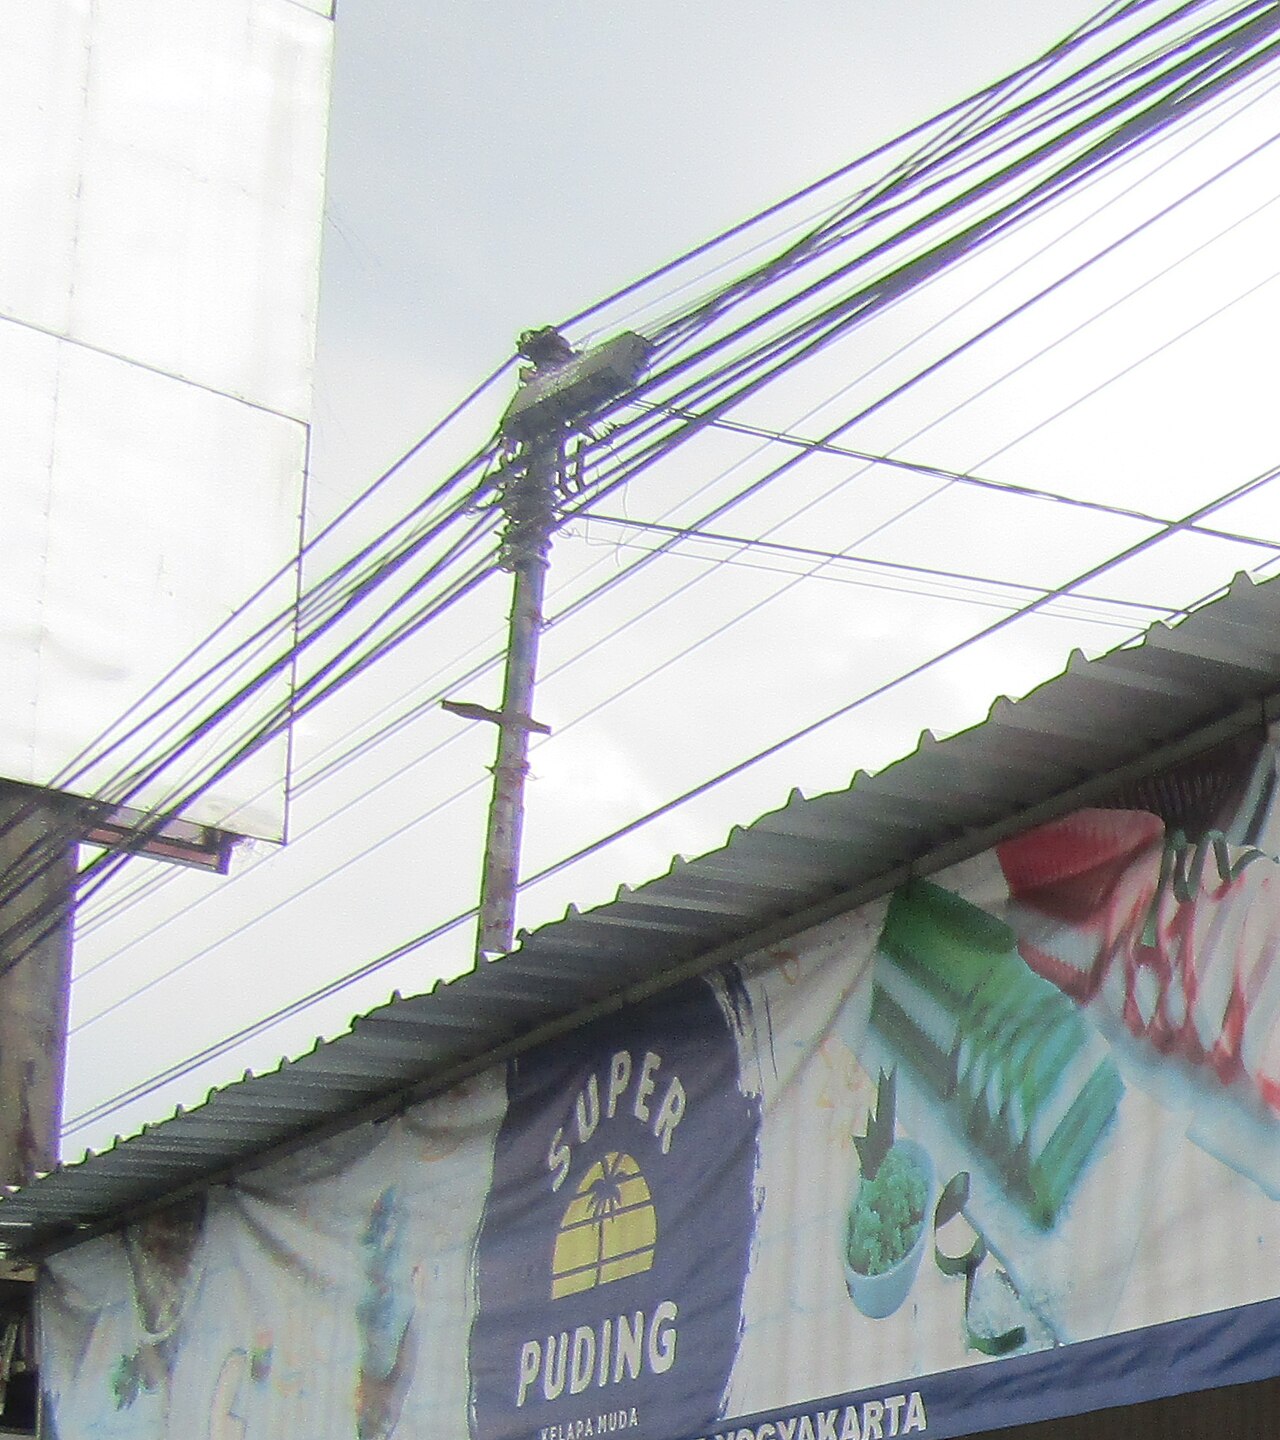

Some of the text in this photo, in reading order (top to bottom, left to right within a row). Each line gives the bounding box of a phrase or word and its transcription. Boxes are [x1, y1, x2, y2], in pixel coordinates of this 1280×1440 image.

[548, 1049, 687, 1192] SUPER
[516, 1300, 678, 1407] PUDING
[598, 1407, 639, 1434] MUDA
